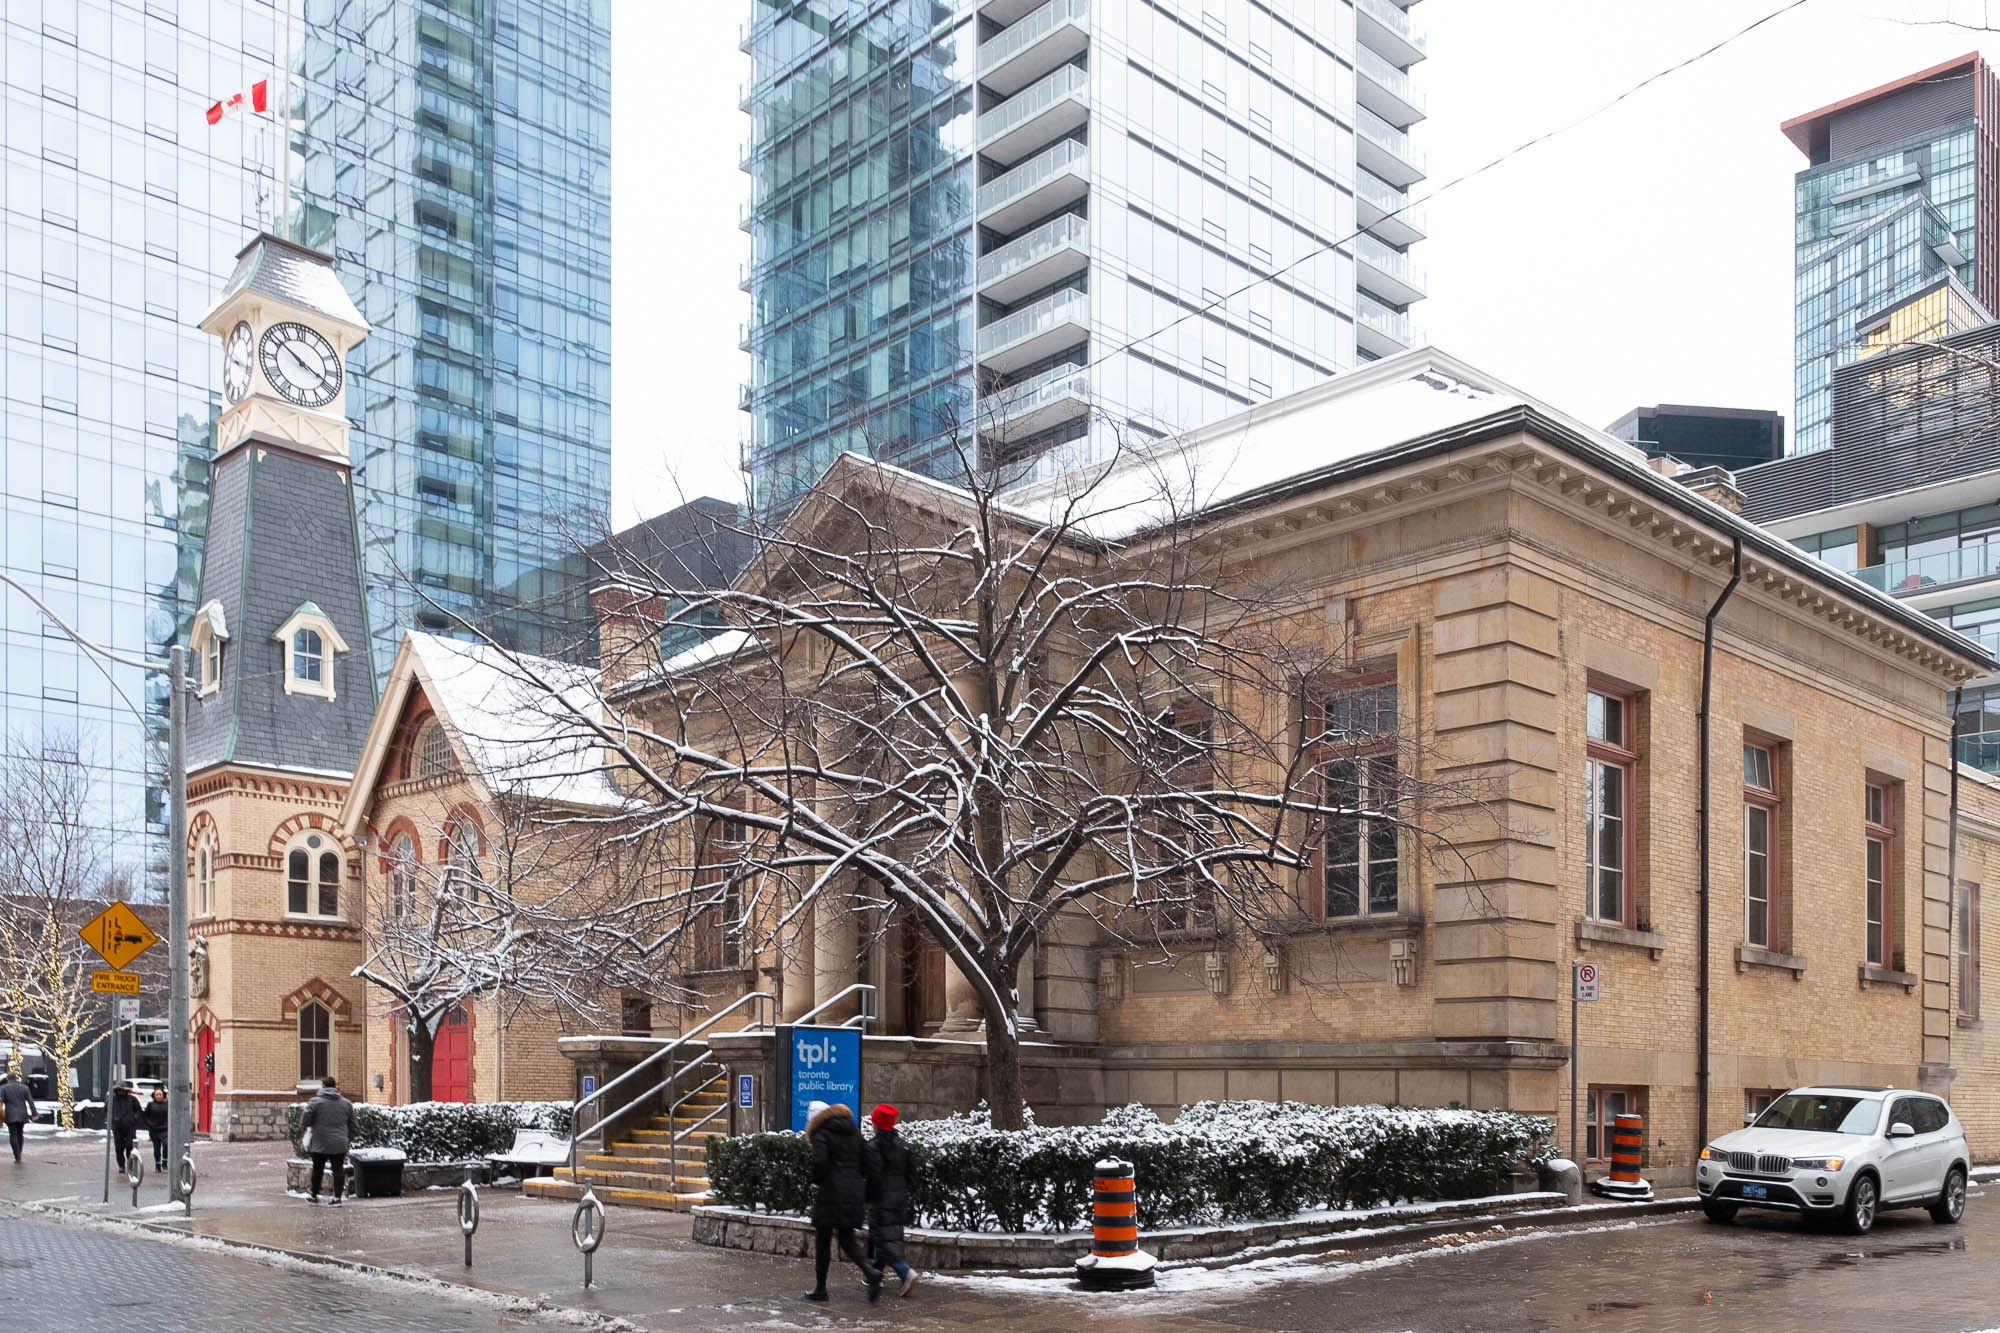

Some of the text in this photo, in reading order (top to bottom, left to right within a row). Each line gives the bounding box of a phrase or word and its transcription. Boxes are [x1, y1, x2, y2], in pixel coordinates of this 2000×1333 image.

[95, 973, 137, 983] FIRE TRUCK
[96, 982, 136, 991] ENTRANCE
[796, 1037, 837, 1069] tpl:
[798, 1070, 830, 1079] toronto
[798, 1080, 854, 1093] public library
